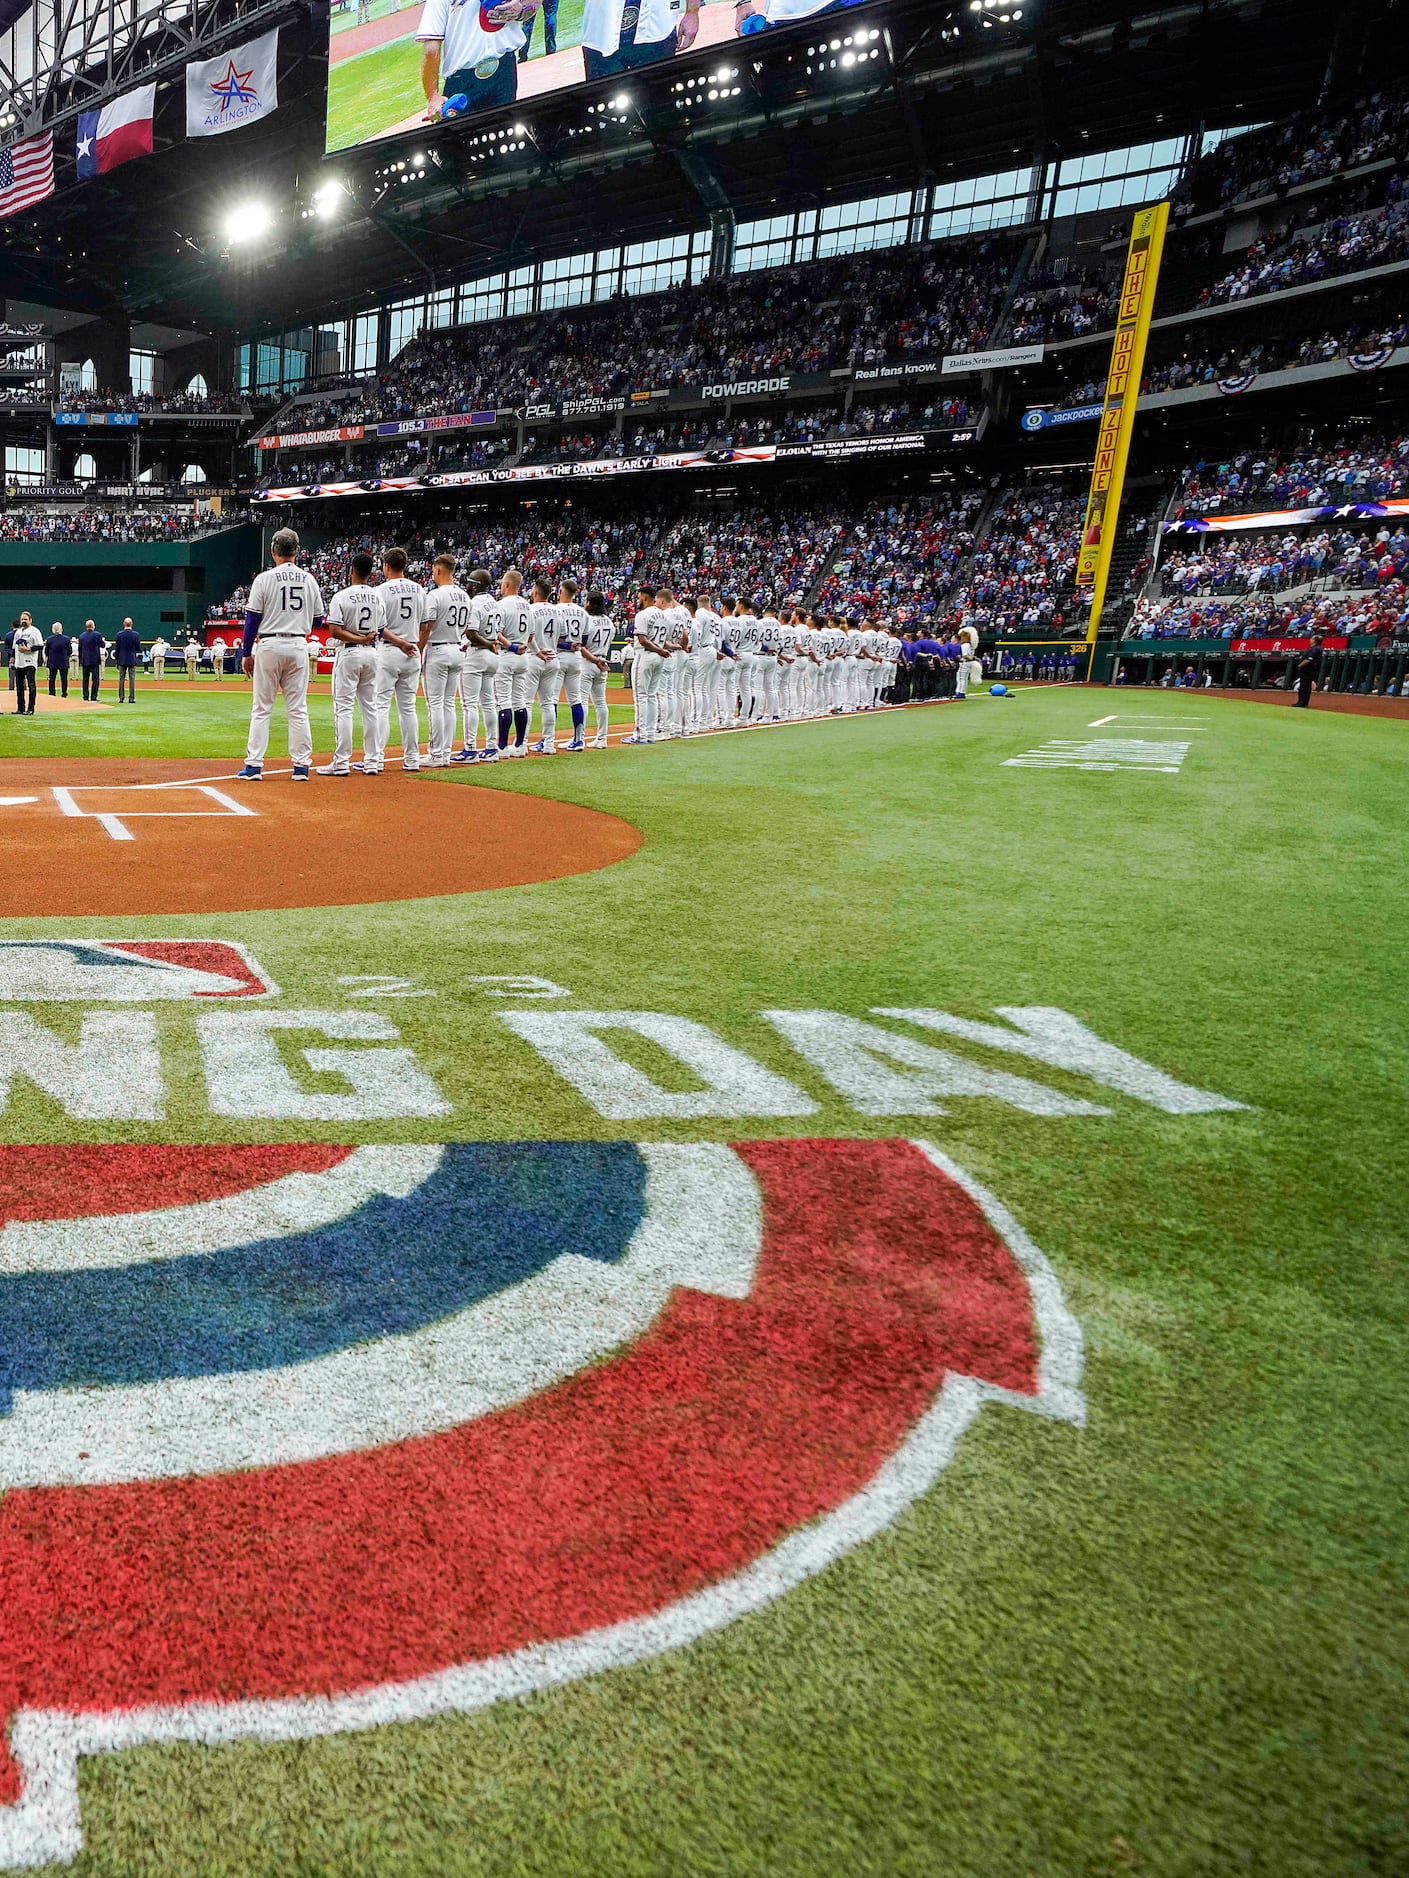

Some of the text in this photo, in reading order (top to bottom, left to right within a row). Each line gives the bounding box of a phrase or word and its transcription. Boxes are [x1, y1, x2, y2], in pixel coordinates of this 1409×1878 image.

[204, 101, 262, 126] ARLINGTON
[856, 362, 937, 380] Real fans know.
[1098, 253, 1142, 490] THE HOT ZONE
[701, 377, 792, 399] POWERADE
[525, 404, 556, 417] PGL
[562, 396, 625, 409] ShipPGL.com
[562, 402, 625, 417] 877.701.1919
[398, 414, 471, 432] 105.3 THE FAN
[279, 429, 341, 447] WHATABURGER
[825, 441, 844, 449] TEXAS
[845, 439, 868, 447] TENORS
[870, 437, 894, 445] HONOR
[895, 434, 924, 443] AMERICA
[952, 433, 973, 442] 2:59
[812, 448, 826, 456] WITH
[827, 447, 838, 455] THE
[839, 445, 866, 454] SINGING
[876, 443, 891, 451] OUR
[892, 441, 925, 450] NATIONAL
[433, 475, 445, 485] OH
[449, 474, 467, 484] SAY
[470, 473, 490, 482] CAN
[492, 470, 512, 480] YOU
[516, 470, 532, 479] SEE
[535, 468, 548, 477] BY
[552, 466, 571, 475] THE
[617, 459, 651, 470] EARLY
[17, 487, 83, 495] PRIORITY GOLD
[107, 486, 165, 496] HART HVAC
[187, 489, 236, 497] PLUCKERS
[276, 571, 307, 584] BOCHY
[280, 586, 303, 611] 15
[449, 592, 467, 603] LOWE
[400, 597, 412, 620] 5
[447, 605, 468, 627] 30
[359, 607, 371, 630] 2
[519, 614, 527, 633] 6
[544, 619, 554, 638] 4
[566, 620, 580, 637] 13
[652, 626, 666, 643] 72
[730, 629, 741, 643] 50
[745, 629, 758, 642] 46
[592, 629, 610, 647] 47
[492, 1003, 1249, 1118] DAY
